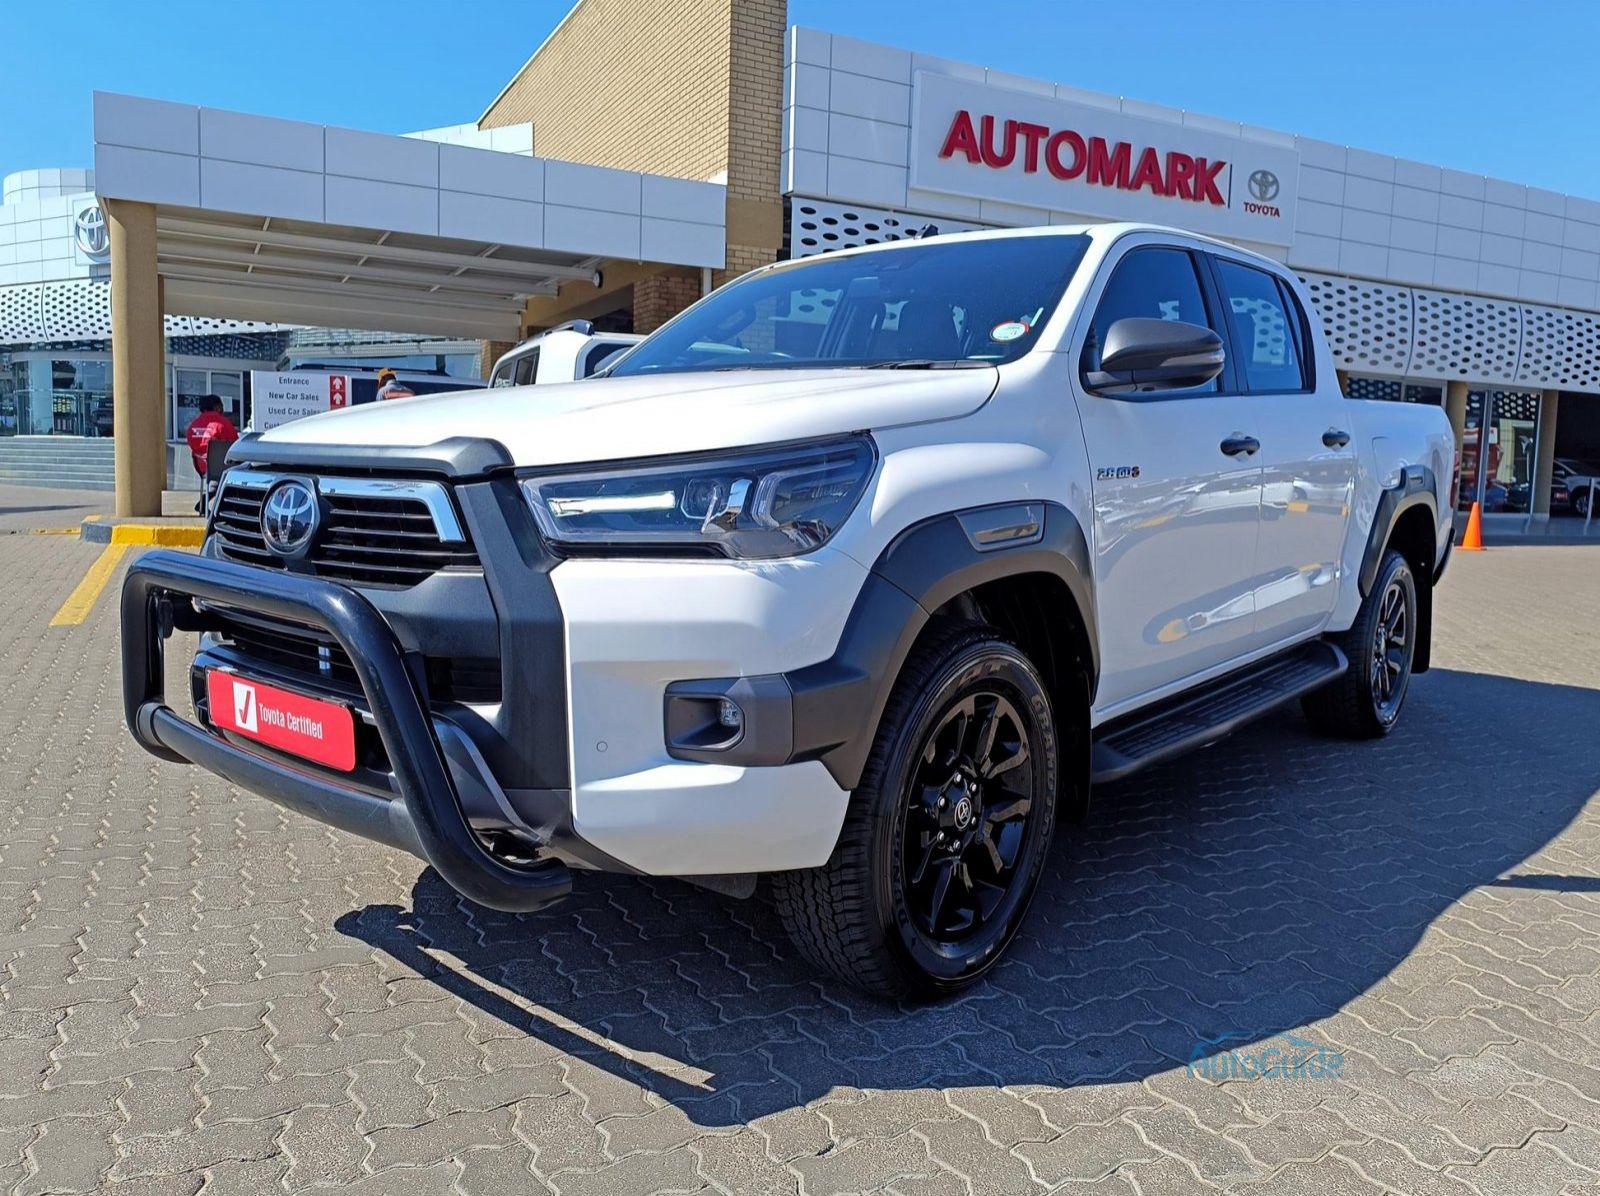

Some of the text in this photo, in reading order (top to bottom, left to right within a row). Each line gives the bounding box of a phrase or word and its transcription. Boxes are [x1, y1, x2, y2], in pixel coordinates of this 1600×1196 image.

[938, 110, 1227, 206] AUTOMARK
[1243, 201, 1280, 218] TOYOTA
[278, 376, 310, 386] Entrance
[268, 391, 319, 401] New Car Sales
[268, 407, 286, 415] Used
[287, 407, 300, 416] Car
[259, 703, 324, 740] Toyota Certified
